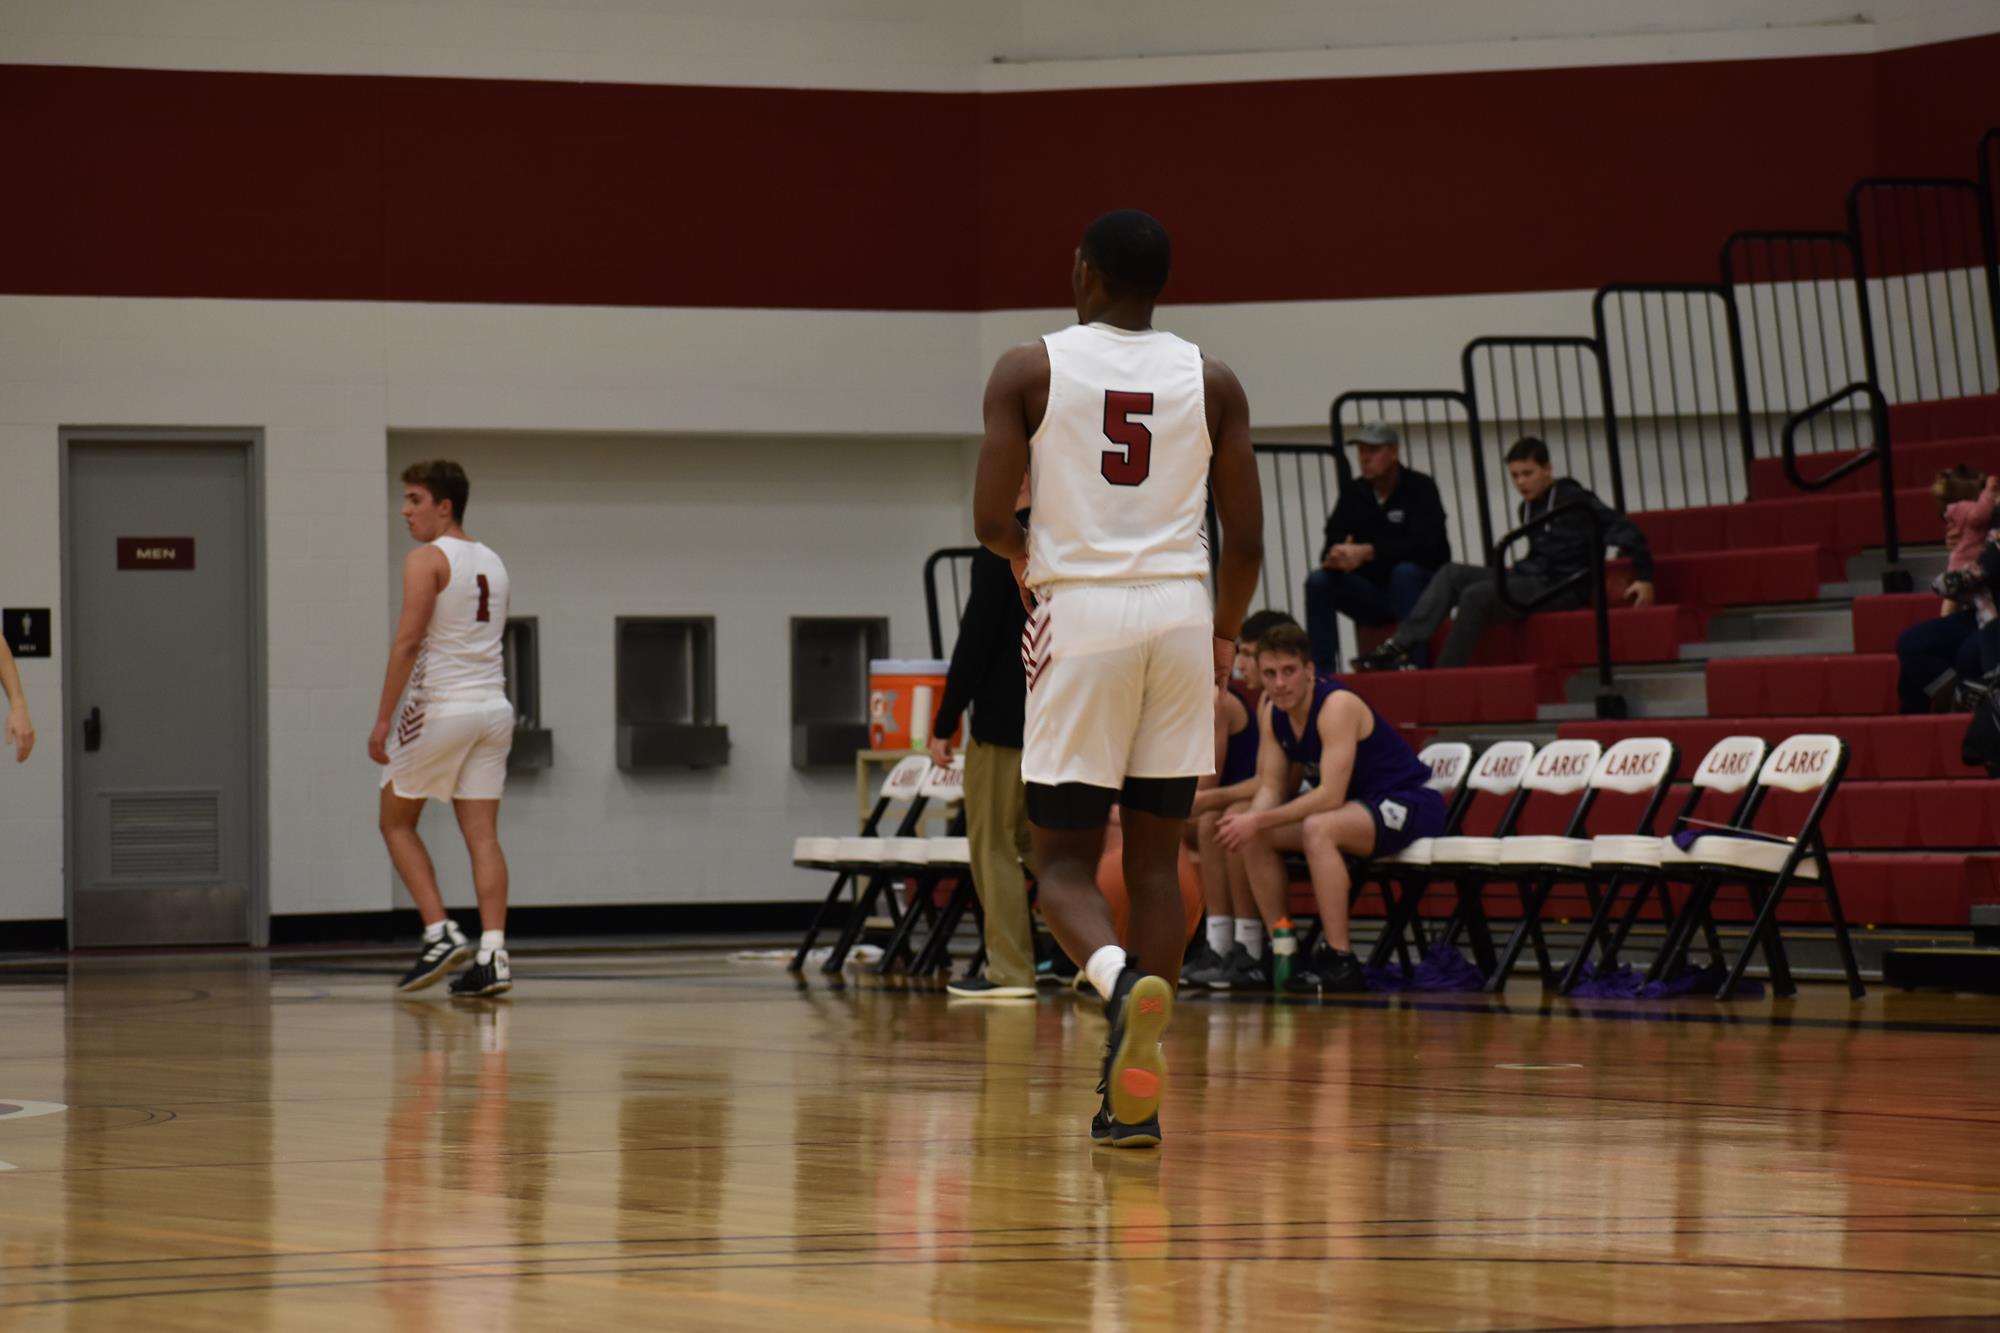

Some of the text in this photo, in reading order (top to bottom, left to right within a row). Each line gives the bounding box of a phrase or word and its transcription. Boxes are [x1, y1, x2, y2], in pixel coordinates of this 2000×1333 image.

[1101, 390, 1153, 486] 5
[136, 547, 176, 559] MEN
[476, 574, 490, 622] 1
[1431, 757, 1461, 777] ARKS
[1480, 755, 1524, 777] LARKS
[1536, 753, 1589, 776] LARKS
[1605, 751, 1660, 775] LARKS
[1708, 751, 1753, 774] LARKS
[1774, 749, 1828, 773] LARKS
